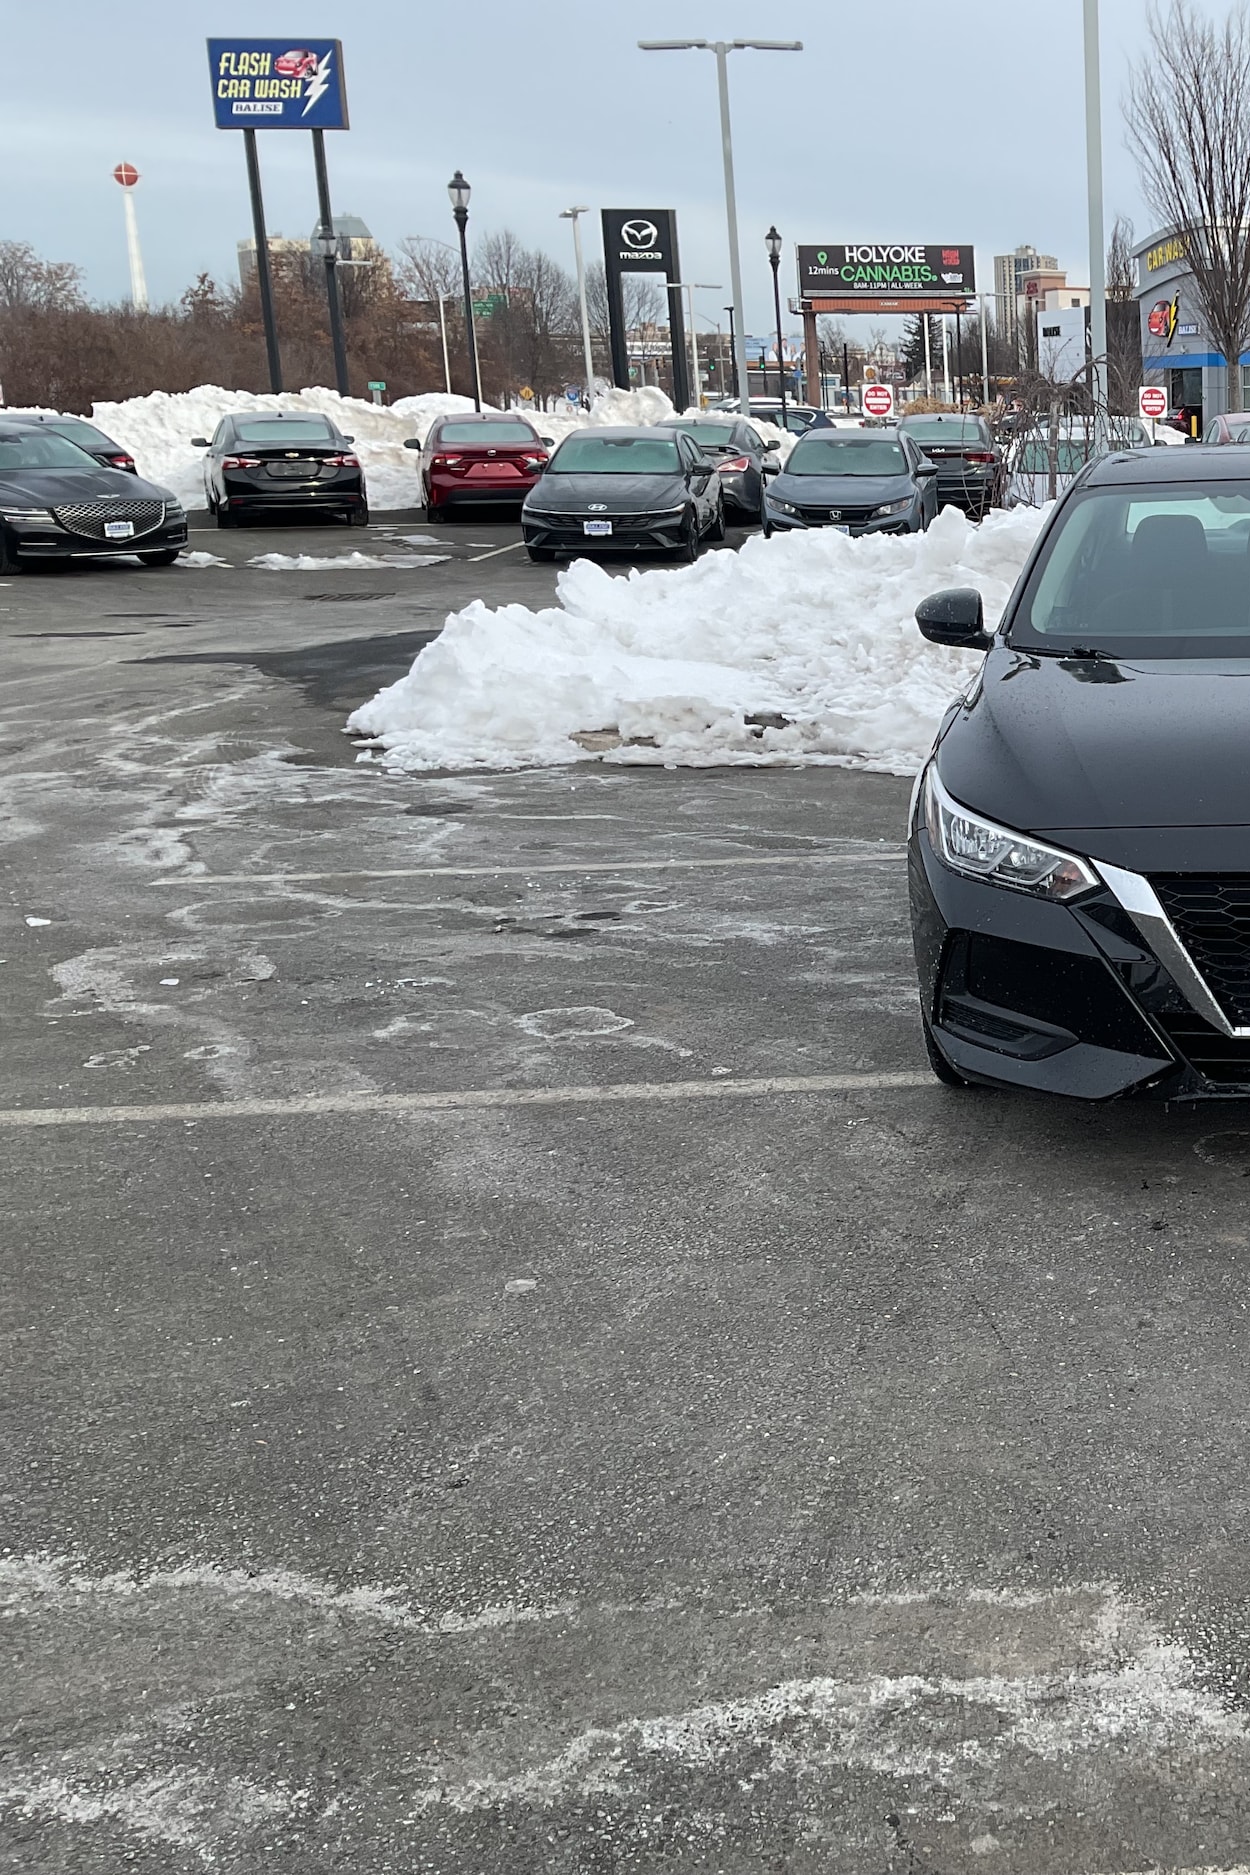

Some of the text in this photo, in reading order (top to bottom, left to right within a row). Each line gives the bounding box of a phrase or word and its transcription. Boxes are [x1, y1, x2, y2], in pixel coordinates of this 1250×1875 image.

[219, 52, 271, 75] FLASH
[218, 79, 302, 98] CAR WASH
[235, 104, 281, 112] BALISE
[845, 246, 926, 263] HOLYOKE
[1147, 247, 1164, 272] CAR
[808, 266, 840, 275] 12mins
